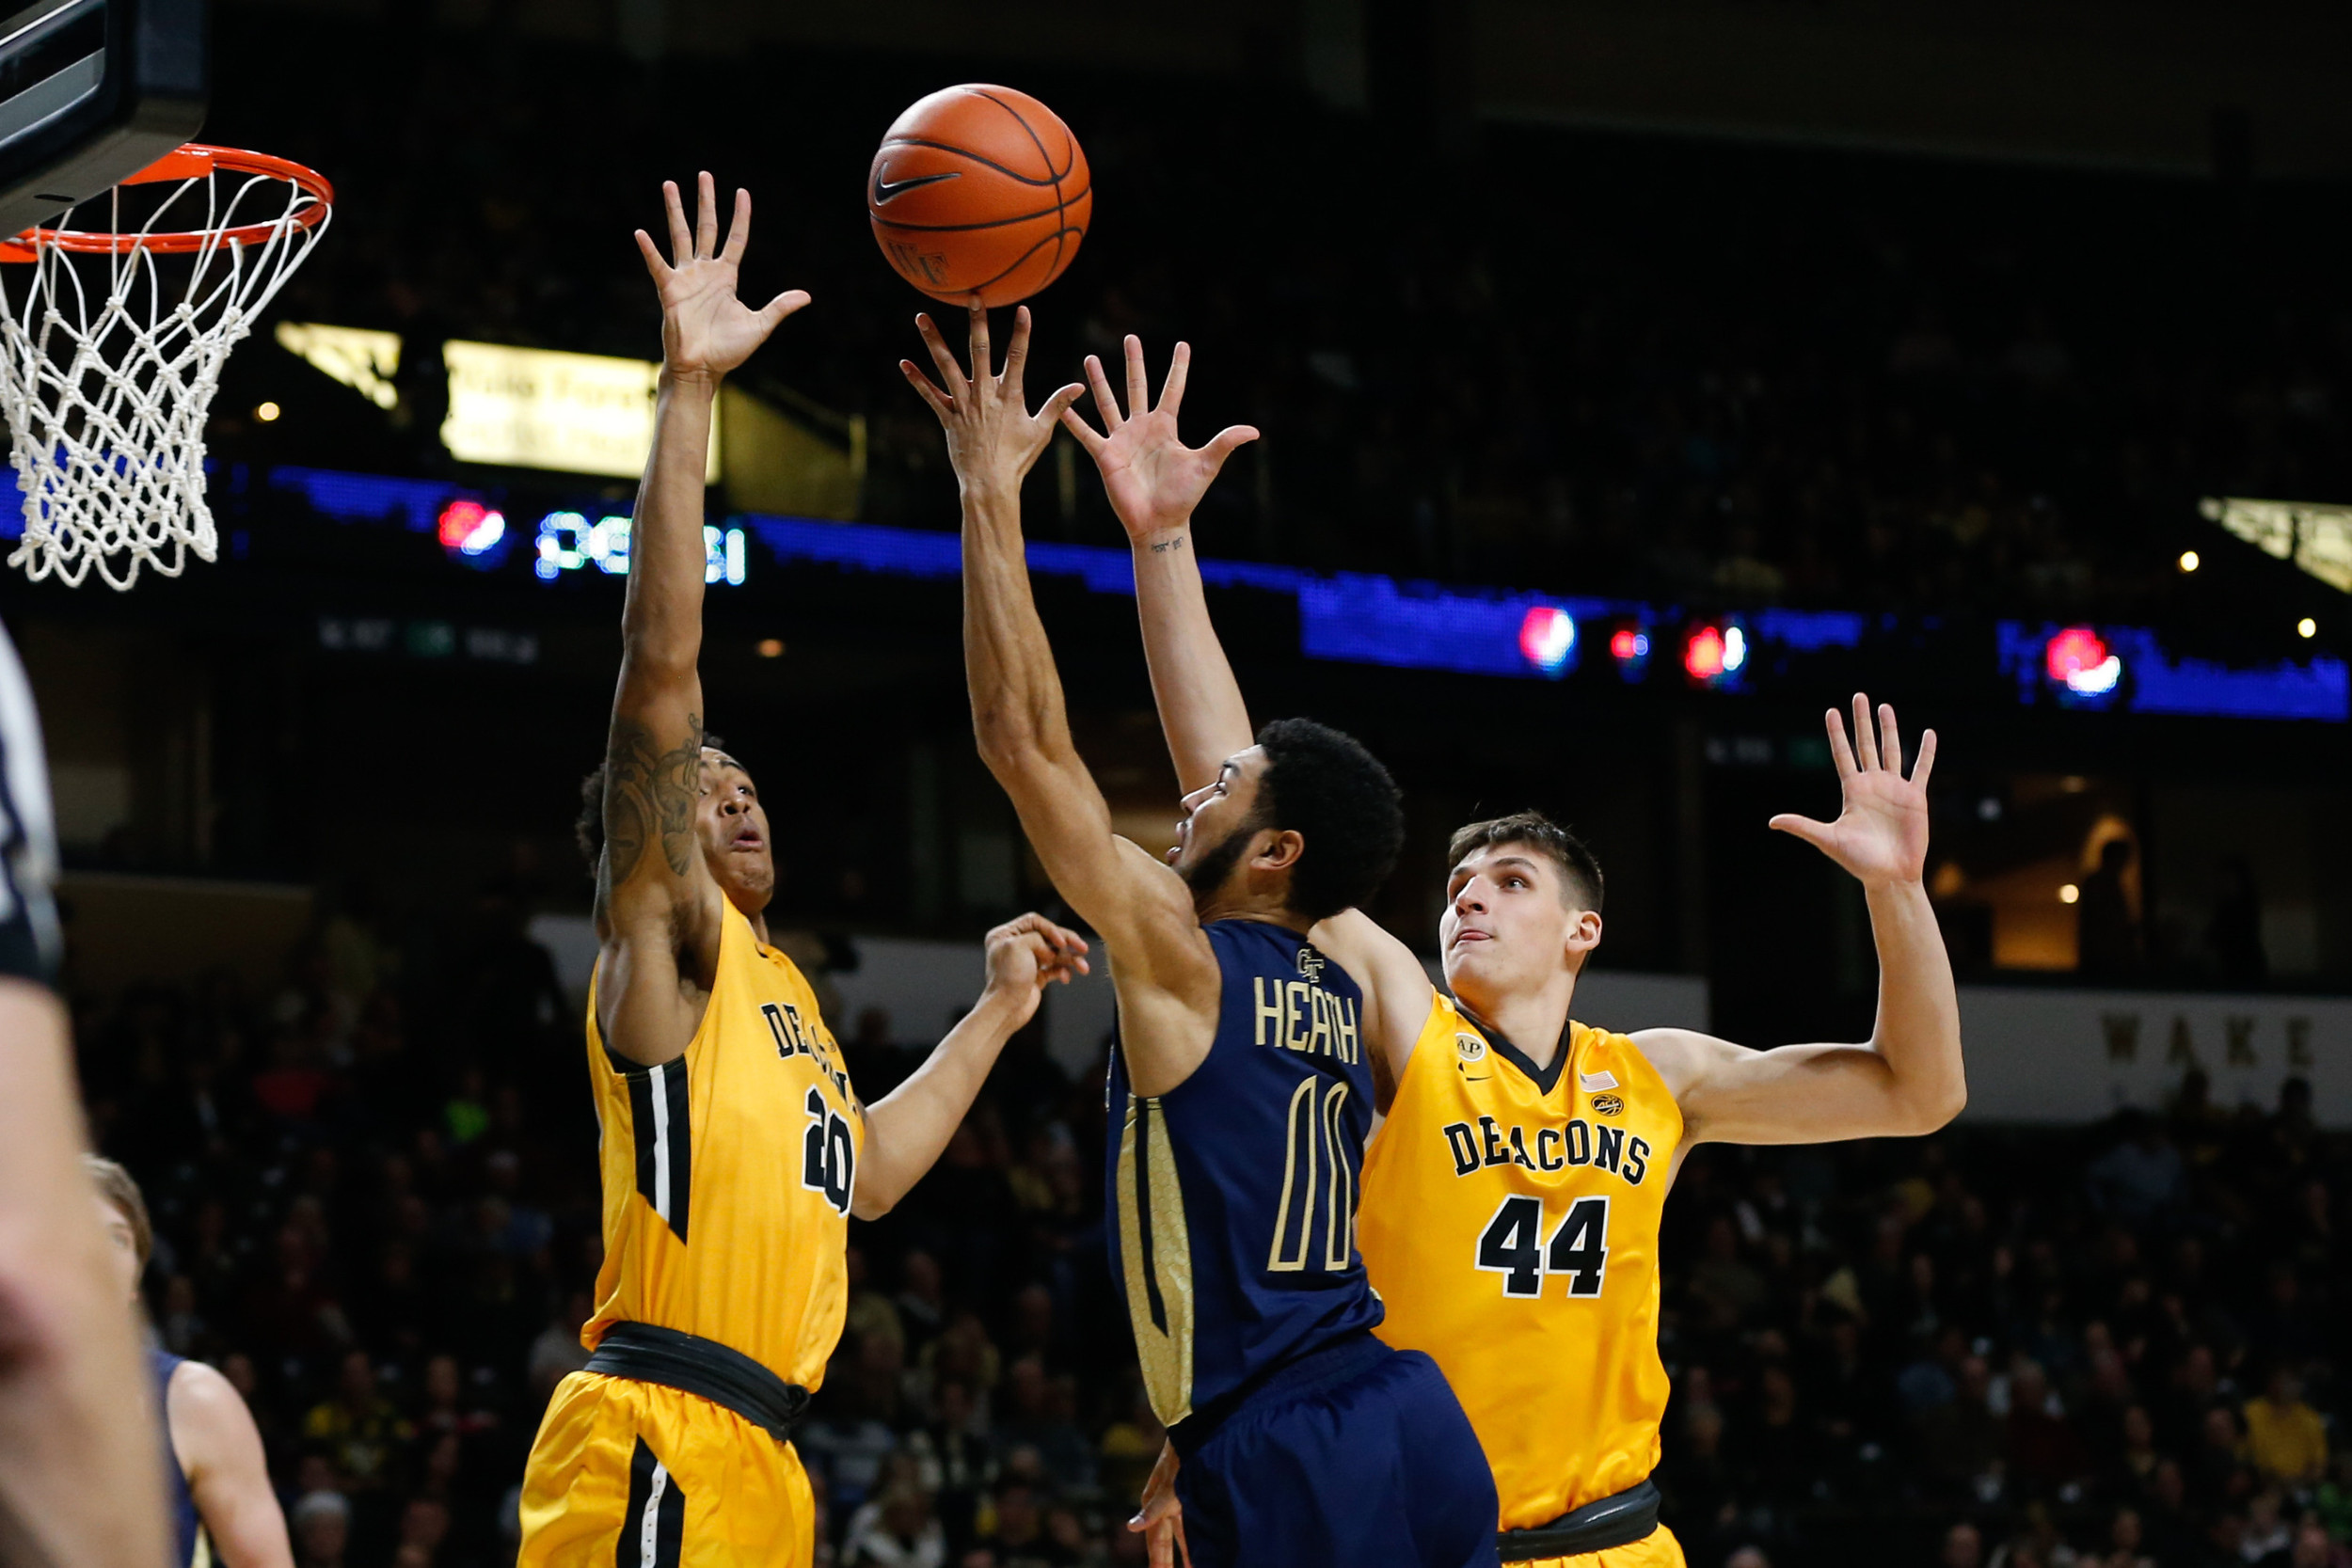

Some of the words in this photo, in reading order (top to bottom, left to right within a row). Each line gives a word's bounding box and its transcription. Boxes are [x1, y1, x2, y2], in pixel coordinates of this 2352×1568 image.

[534, 511, 746, 585] pesi
[1296, 948, 1325, 984] GT
[1254, 975, 1359, 1066] HEATH
[2099, 1010, 2315, 1068] WAKE
[802, 1084, 857, 1219] 20
[1266, 1074, 1353, 1272] 11
[1442, 1115, 1651, 1187] DEACONS
[1474, 1193, 1612, 1299] 44
